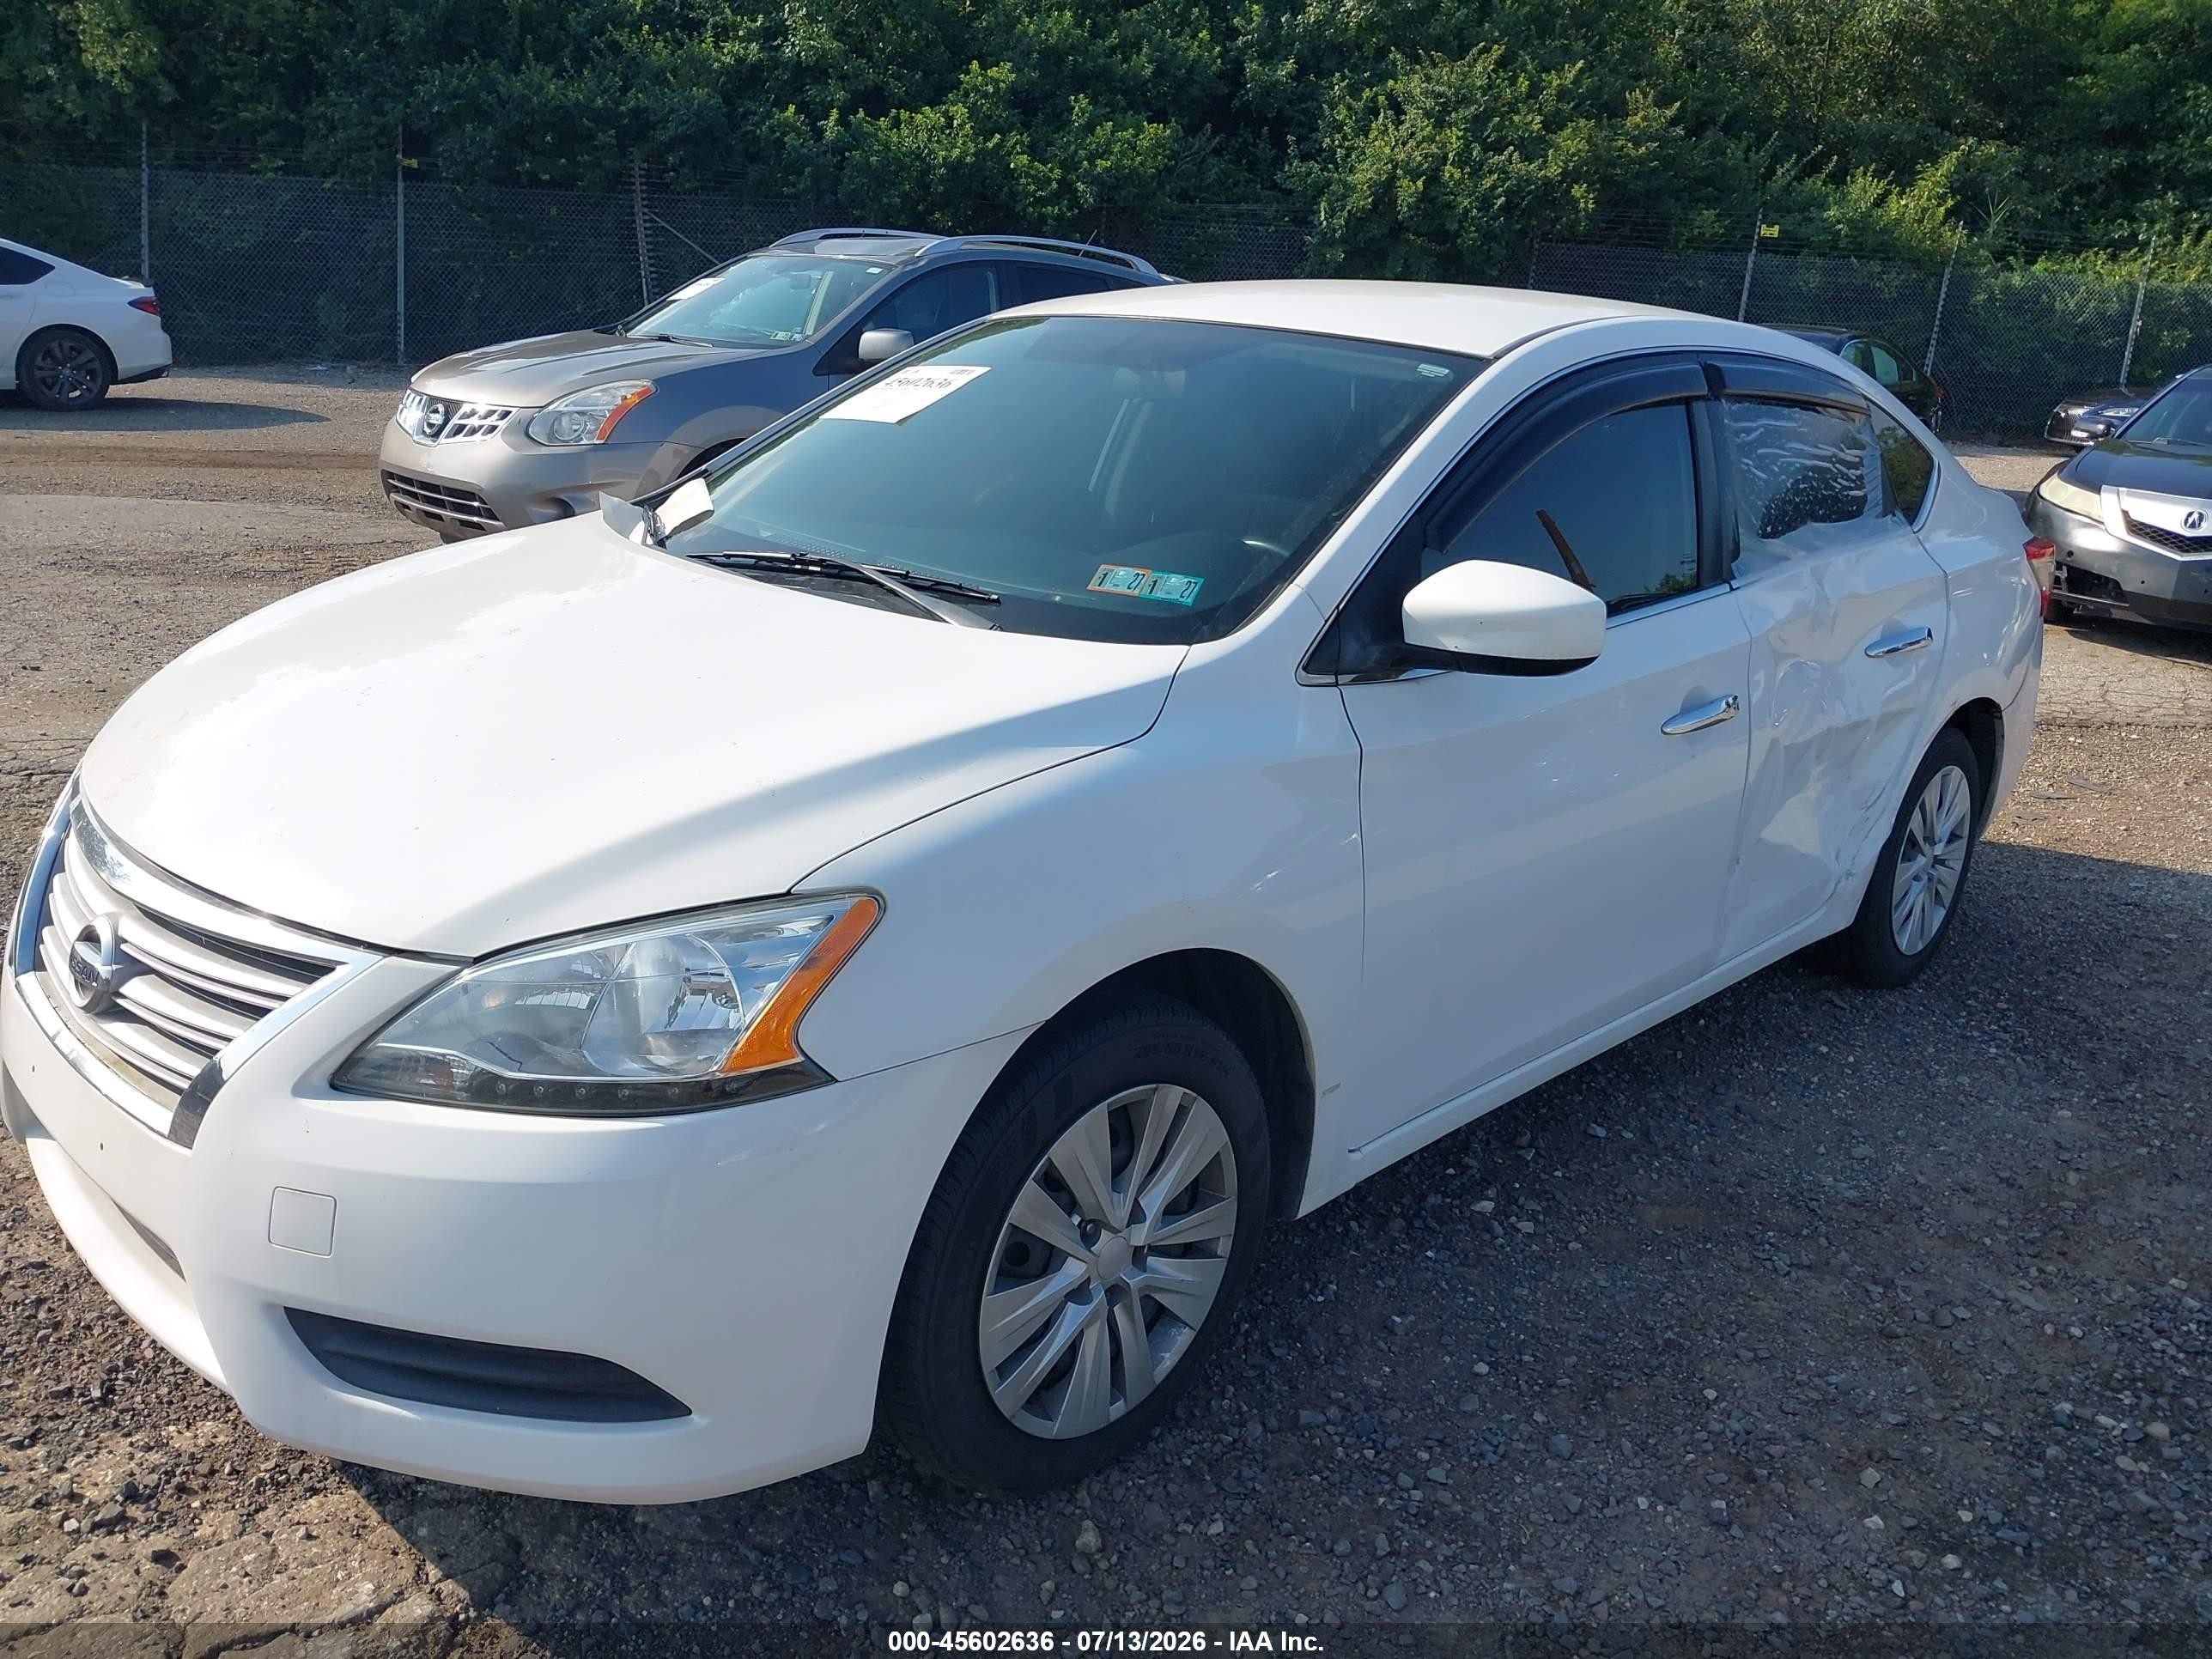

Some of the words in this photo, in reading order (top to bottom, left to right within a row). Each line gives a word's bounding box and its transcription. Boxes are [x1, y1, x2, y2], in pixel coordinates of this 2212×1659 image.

[1098, 572, 1109, 587] 1
[1127, 572, 1146, 592] 27
[1148, 579, 1158, 595] 1
[1180, 580, 1199, 600] 27
